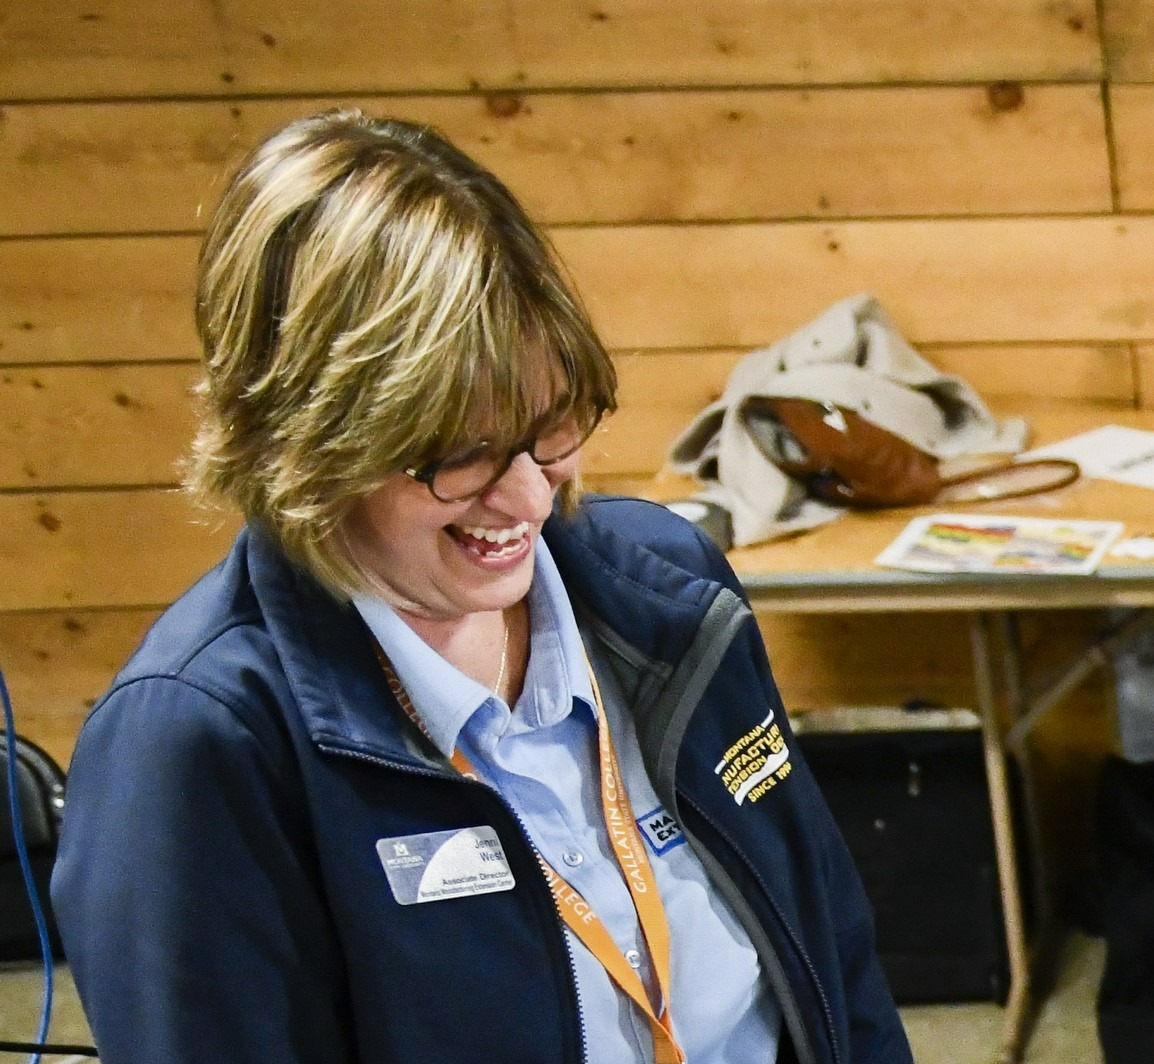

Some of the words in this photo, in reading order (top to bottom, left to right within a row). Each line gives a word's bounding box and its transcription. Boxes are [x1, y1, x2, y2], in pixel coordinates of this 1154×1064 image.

[747, 776, 777, 803] SINCE
[479, 850, 504, 862] West
[608, 807, 647, 893] GALLATIN
[442, 874, 478, 885] Associate
[479, 870, 509, 881] Director
